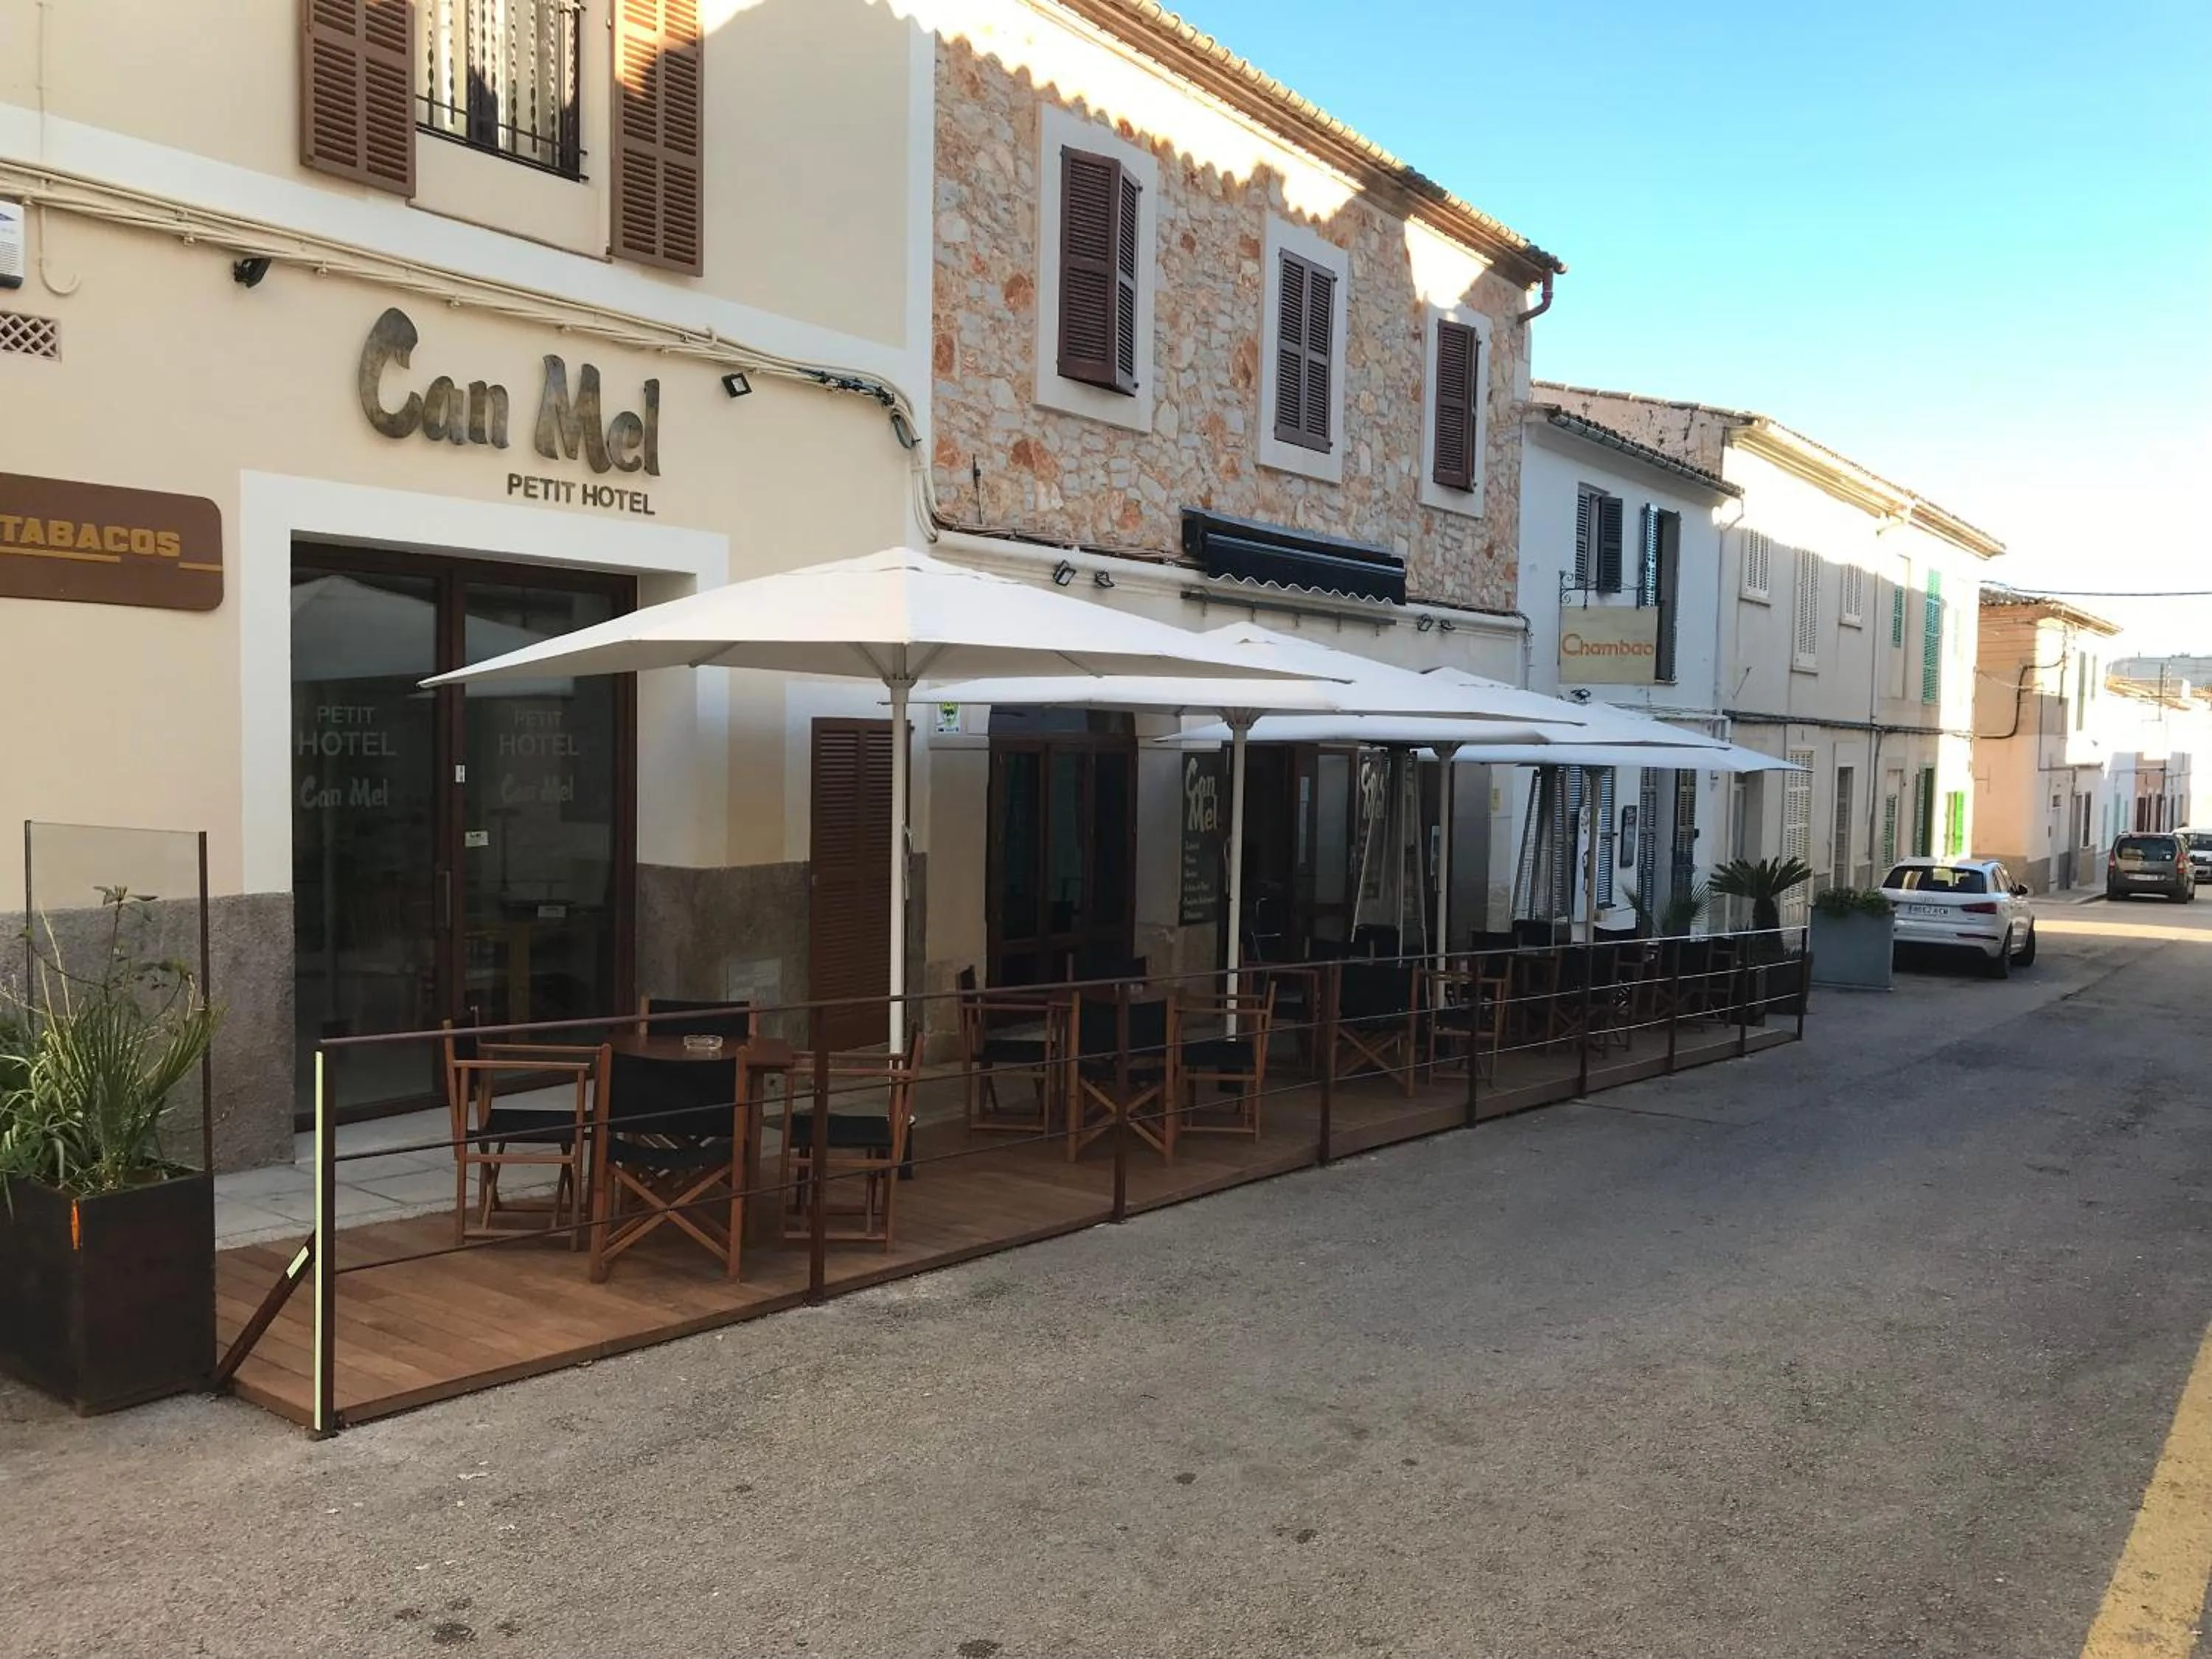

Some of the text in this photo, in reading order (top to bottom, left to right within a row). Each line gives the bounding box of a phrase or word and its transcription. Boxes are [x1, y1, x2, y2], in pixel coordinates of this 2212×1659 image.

[358, 307, 661, 476] Can Mel
[507, 473, 655, 515] PETIT HOTEL
[0, 515, 180, 557] TABACOS
[1561, 633, 1654, 656] Chambao
[317, 706, 377, 725] PETIT
[514, 709, 563, 727] PETIT
[298, 730, 397, 756] HOTEL
[499, 733, 580, 757] HOTEL
[300, 774, 389, 809] Can Mel
[1185, 757, 1216, 799] Can
[1187, 792, 1217, 832] Mel
